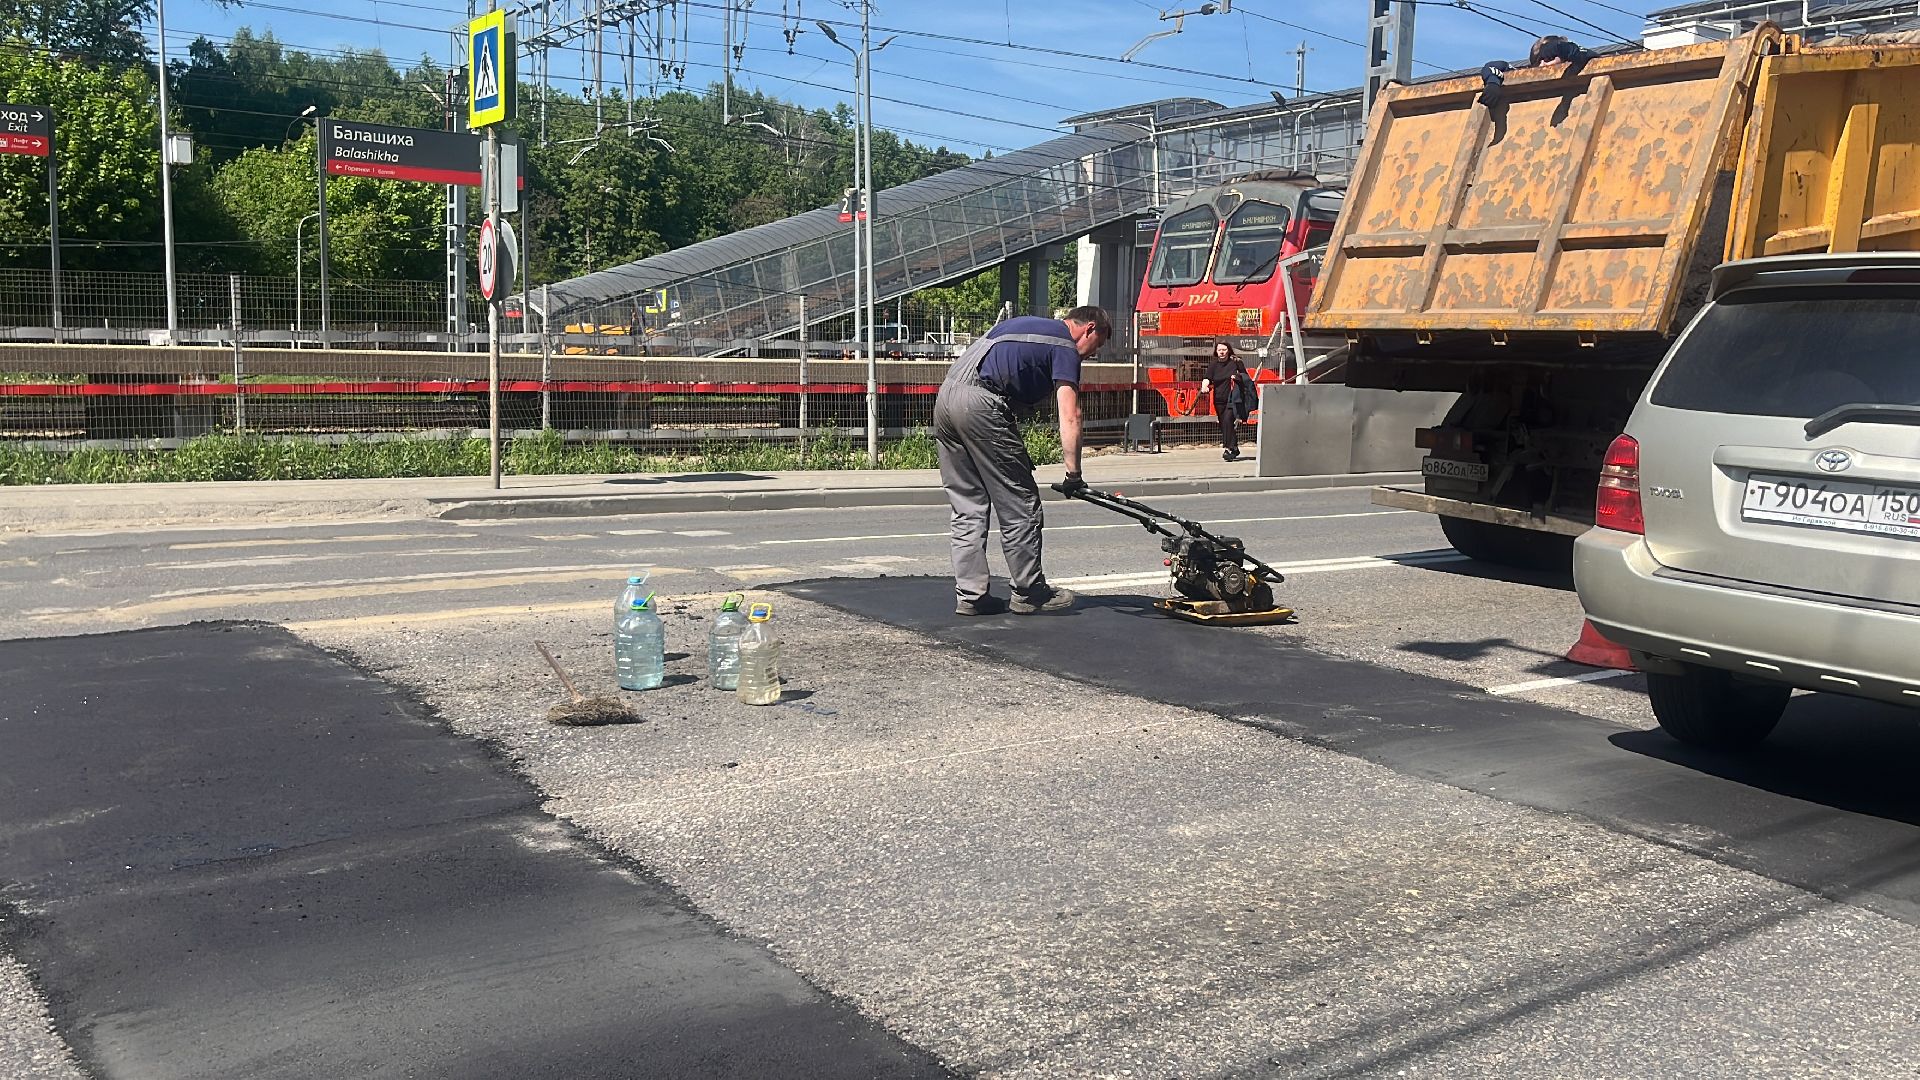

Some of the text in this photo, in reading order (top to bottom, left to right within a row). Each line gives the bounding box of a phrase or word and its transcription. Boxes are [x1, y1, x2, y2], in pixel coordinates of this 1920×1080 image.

[8, 122, 28, 133] Exit
[333, 125, 414, 147] Балашиха
[335, 146, 399, 163] Balashikha
[842, 198, 849, 213] 2
[482, 242, 493, 275] 20
[1877, 489, 1920, 514] 150
[1884, 512, 1907, 522] RUS
